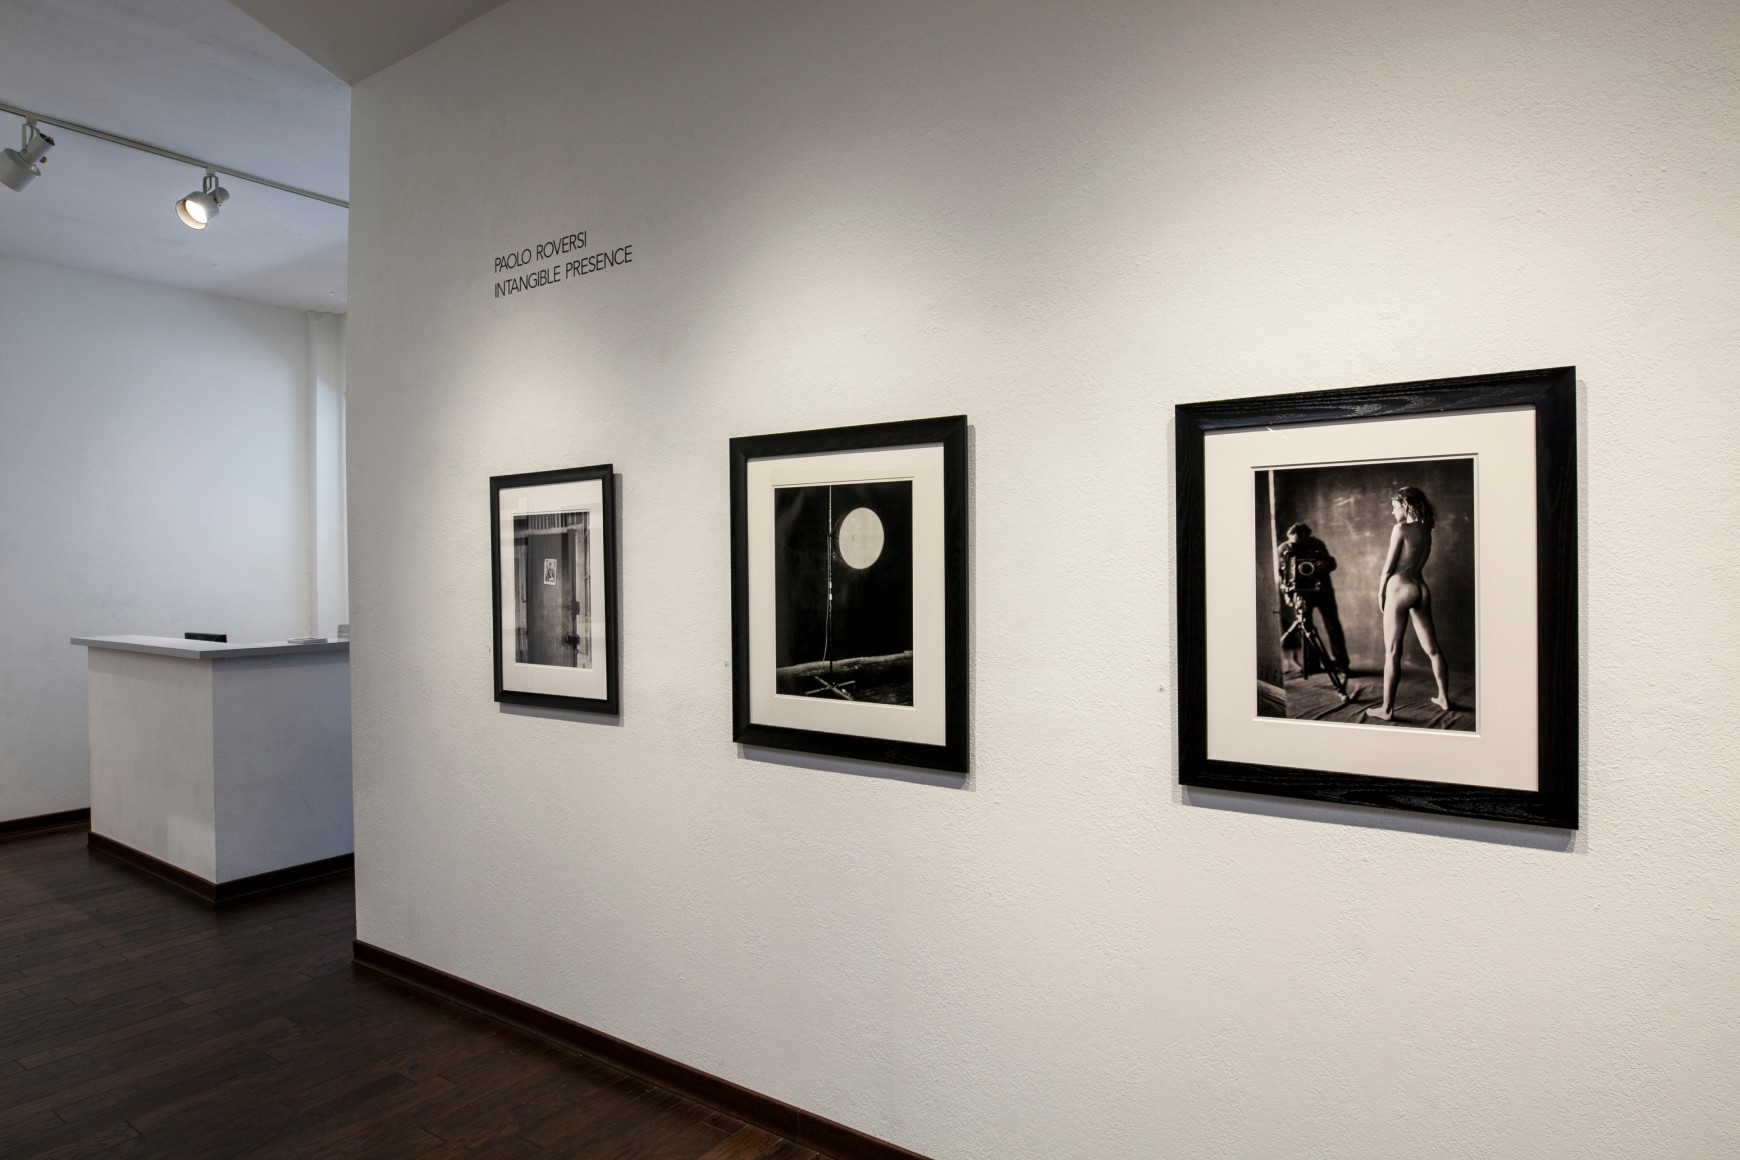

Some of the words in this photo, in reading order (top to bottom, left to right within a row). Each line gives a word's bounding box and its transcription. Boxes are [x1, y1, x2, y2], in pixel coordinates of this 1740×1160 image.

[494, 248, 532, 273] PAOLO
[536, 230, 587, 261] ROVERSI
[494, 265, 561, 299] INTANGIBLE
[565, 245, 633, 279] PRESENCE
